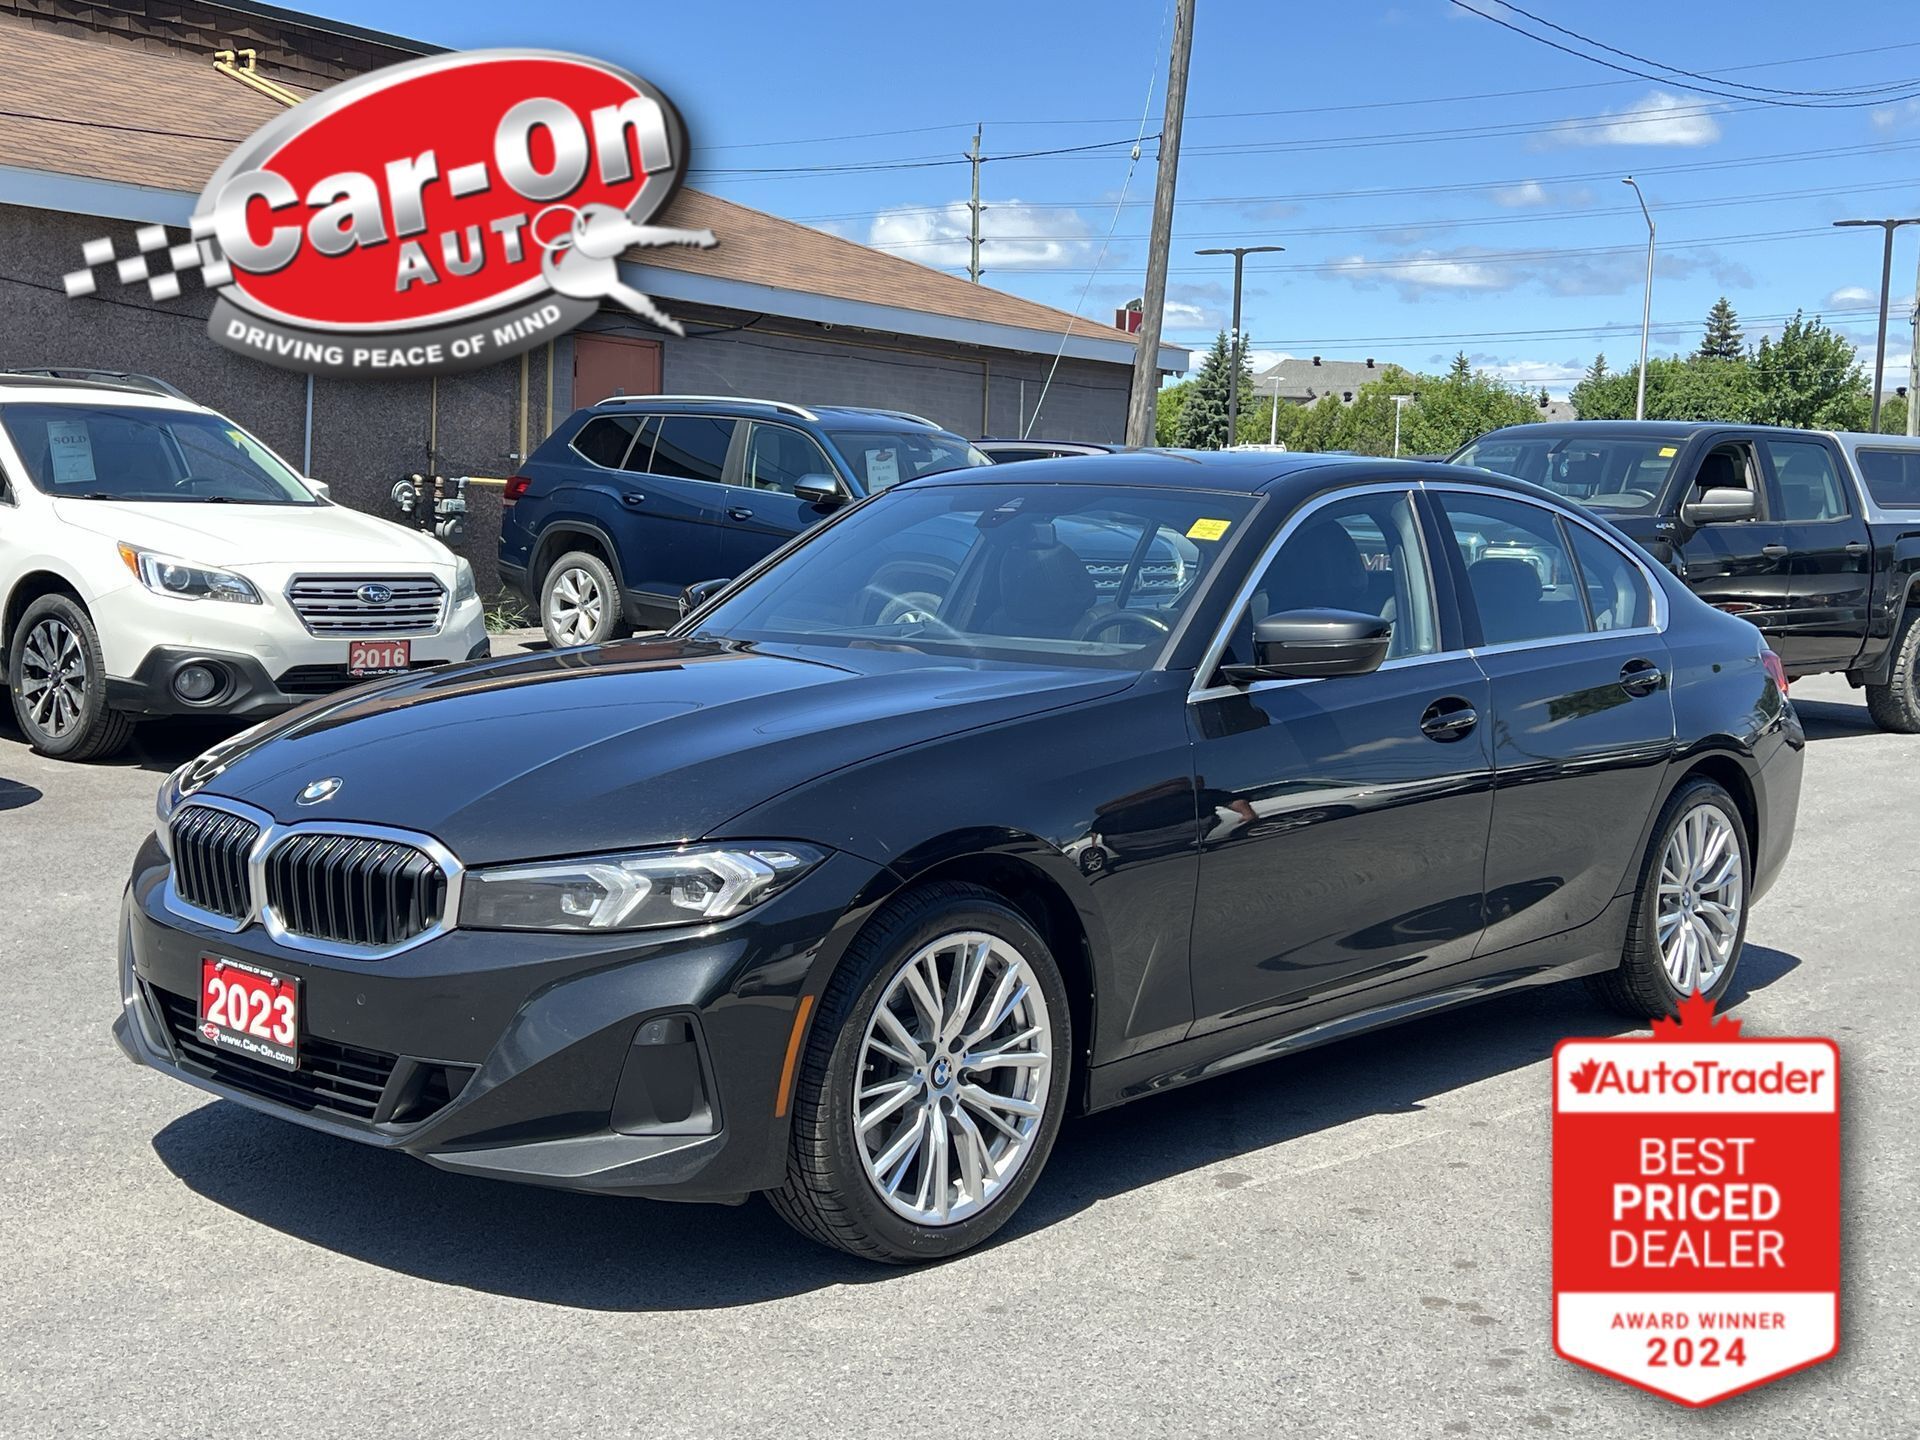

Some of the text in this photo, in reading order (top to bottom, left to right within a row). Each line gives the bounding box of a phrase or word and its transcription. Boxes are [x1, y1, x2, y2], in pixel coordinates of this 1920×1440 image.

[53, 435, 87, 445] SOLD
[353, 647, 406, 668] 2016
[207, 977, 295, 1045] 2023
[220, 1033, 294, 1064] www.Car-On.com
